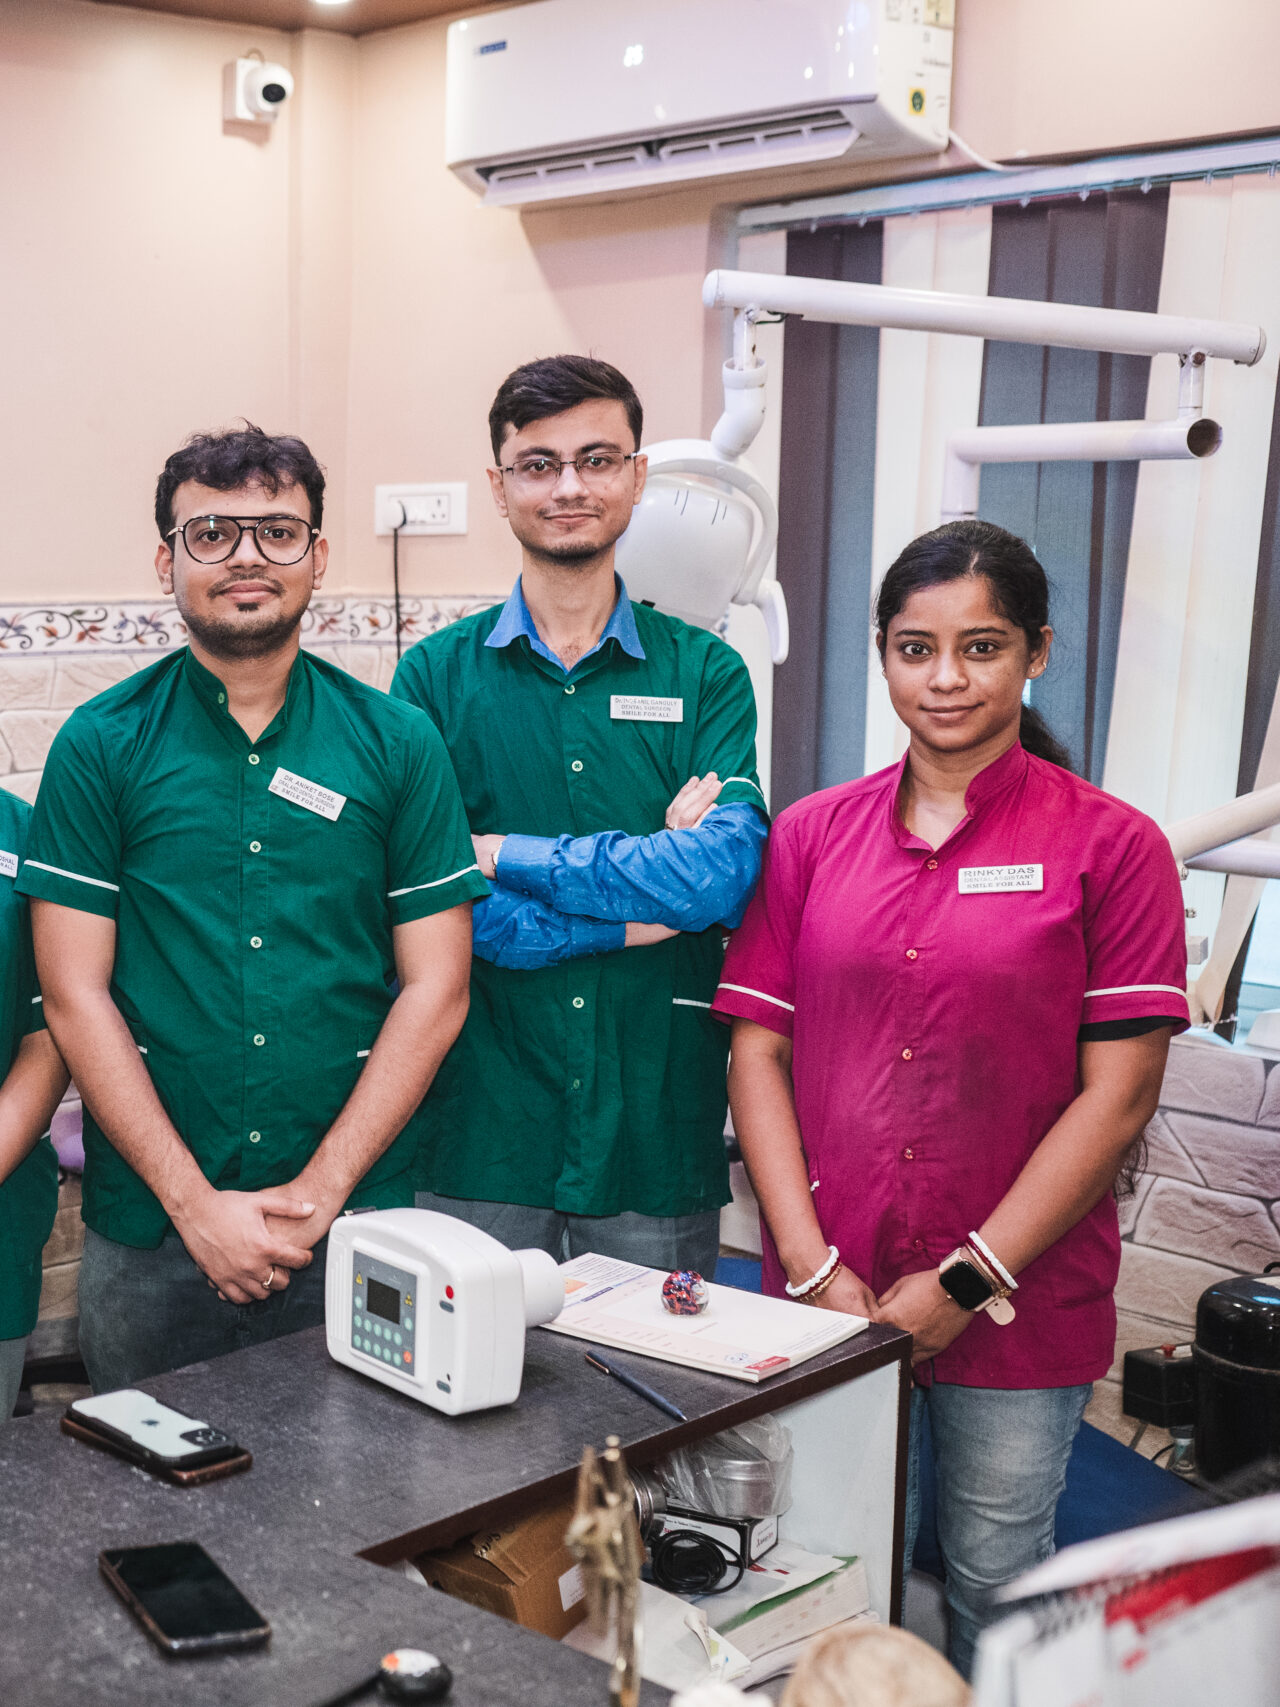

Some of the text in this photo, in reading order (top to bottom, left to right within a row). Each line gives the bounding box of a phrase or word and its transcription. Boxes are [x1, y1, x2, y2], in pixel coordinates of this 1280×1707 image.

[278, 779, 336, 810] ORAL AND DENTAL SURGEON
[281, 788, 326, 812] SMILE FOR ALL
[295, 780, 318, 794] ANIKET
[318, 791, 336, 803] BOSE
[4, 863, 14, 871] ALL
[964, 866, 1035, 878] RINKY DAS
[994, 874, 1035, 882] ASSISTANT
